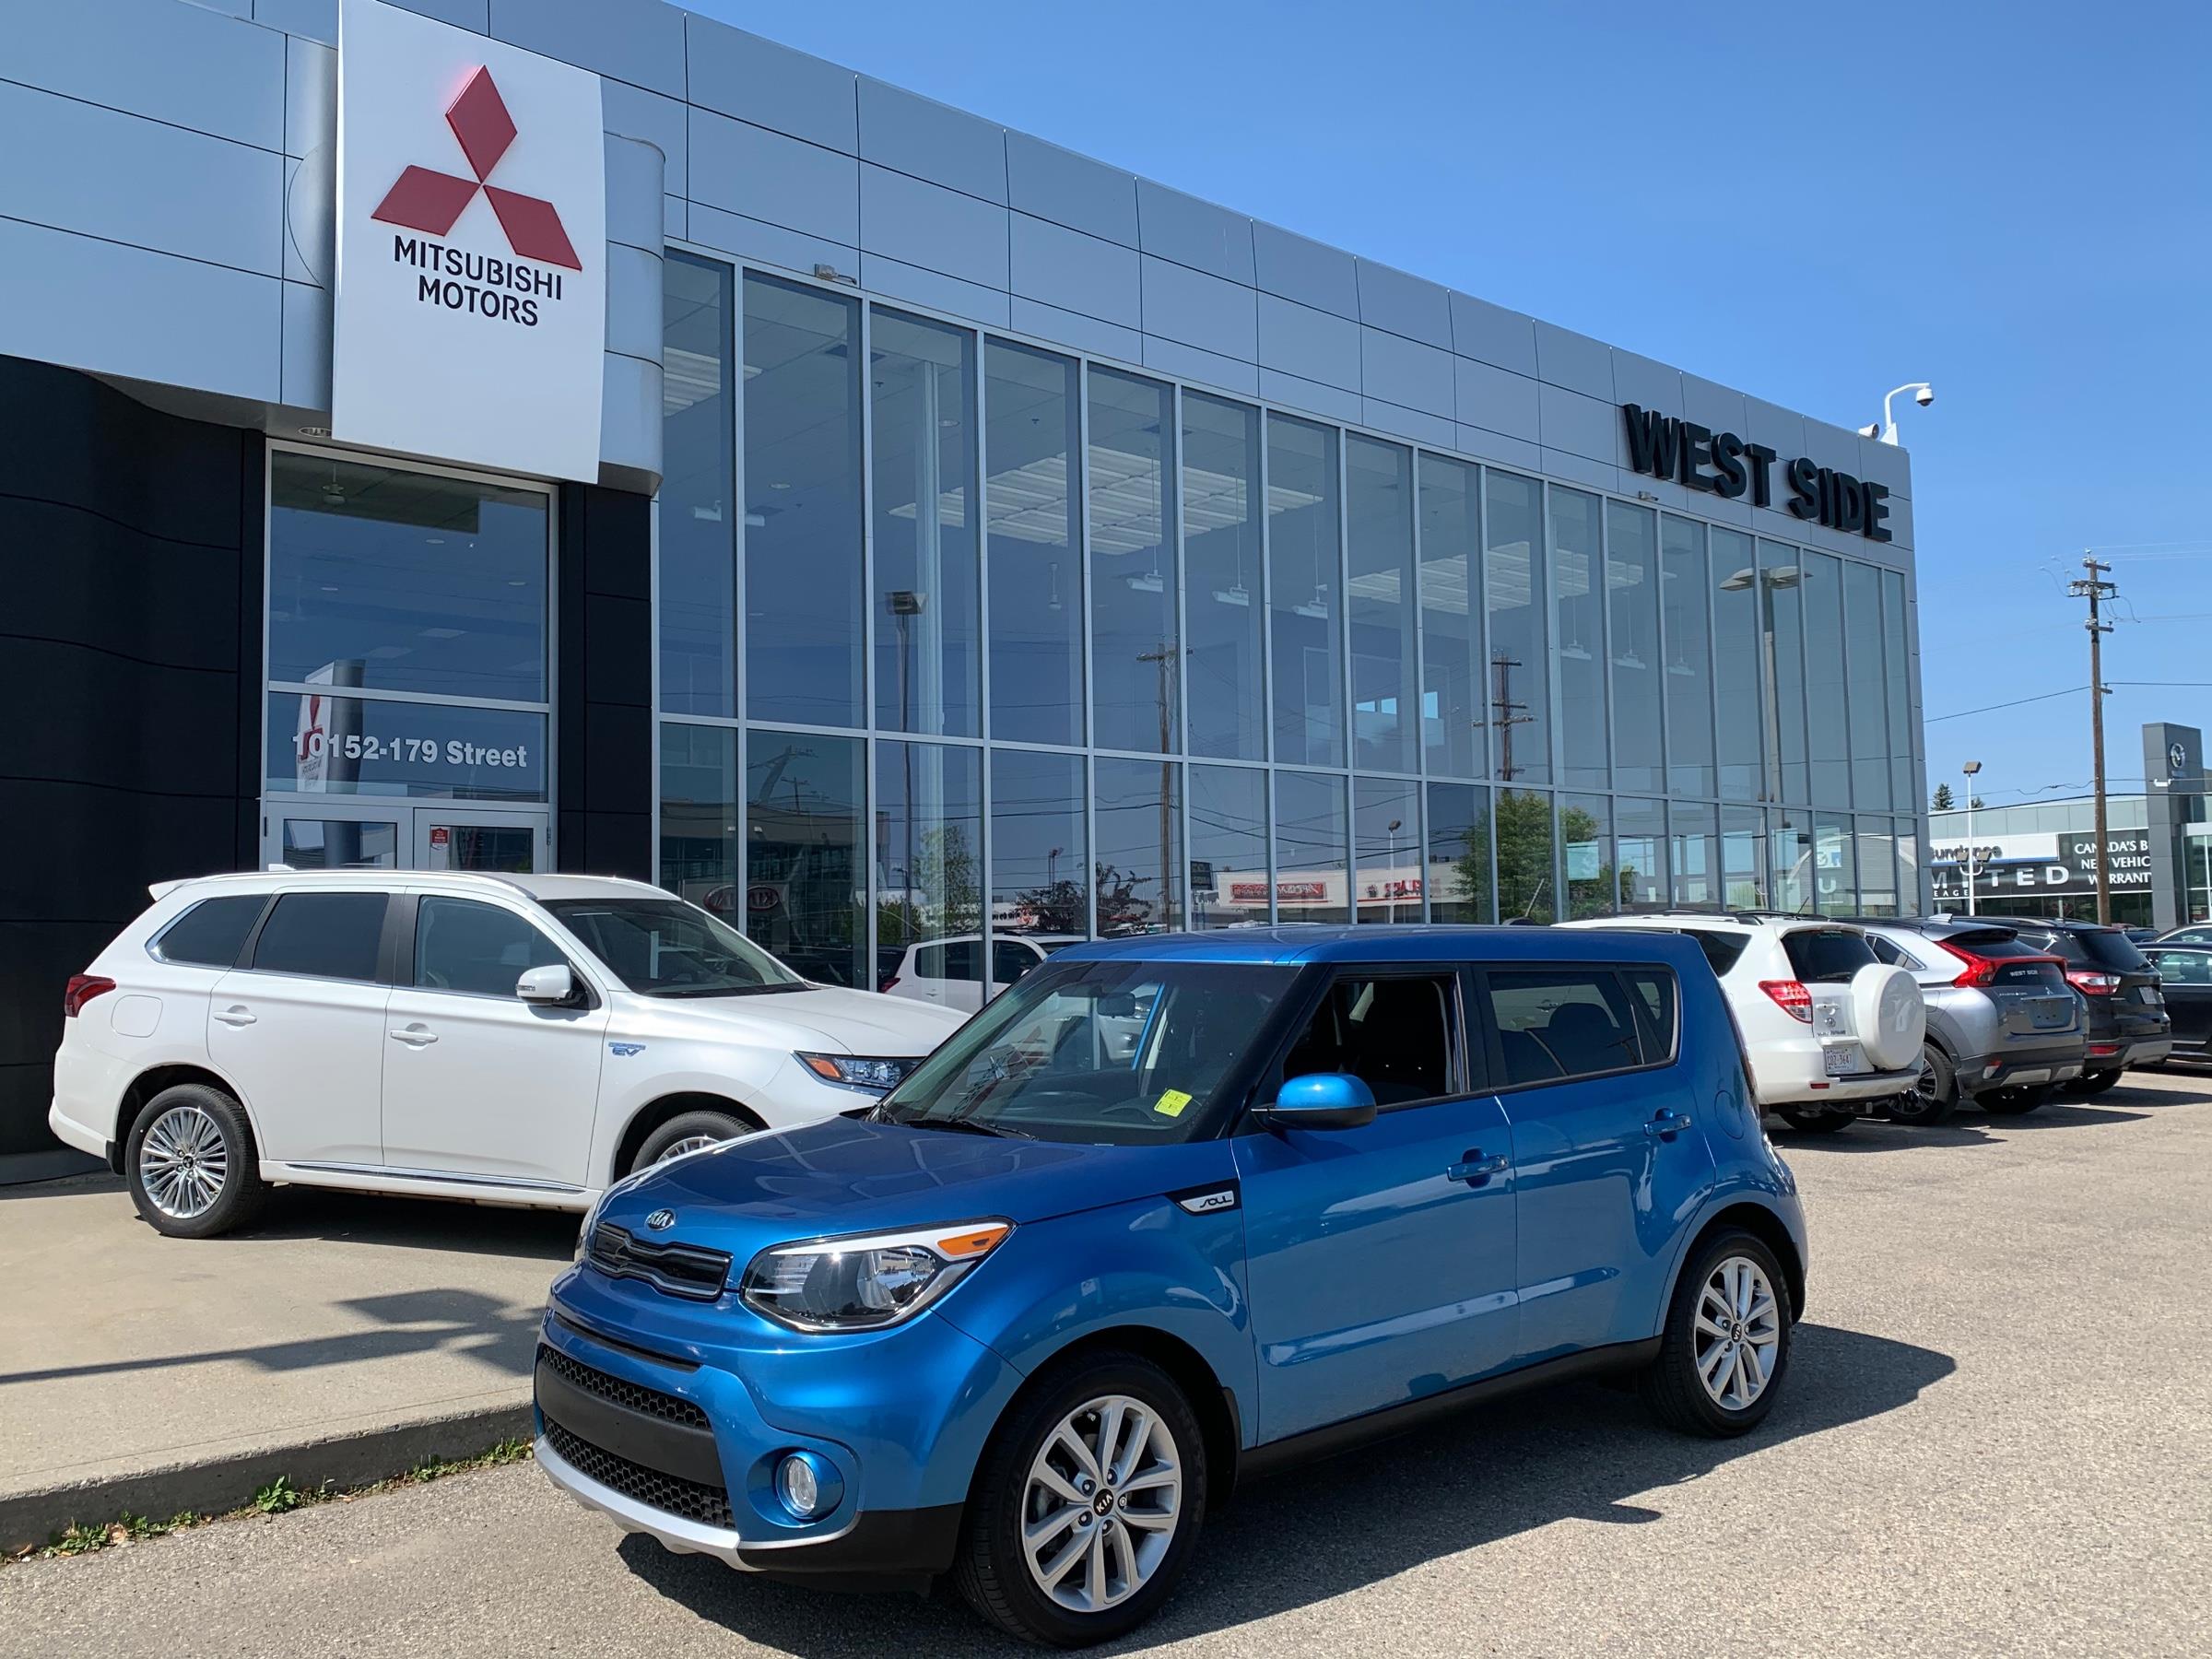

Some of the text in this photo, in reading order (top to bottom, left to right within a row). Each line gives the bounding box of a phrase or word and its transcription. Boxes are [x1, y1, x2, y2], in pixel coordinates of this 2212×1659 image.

[394, 235, 561, 300] MITSUBISHI
[418, 275, 538, 326] MOTORS
[1623, 403, 1892, 543] WEST SIDE
[292, 734, 527, 767] 10152-179 Street
[648, 1211, 671, 1227] KIA
[1097, 1494, 1112, 1512] KIA
